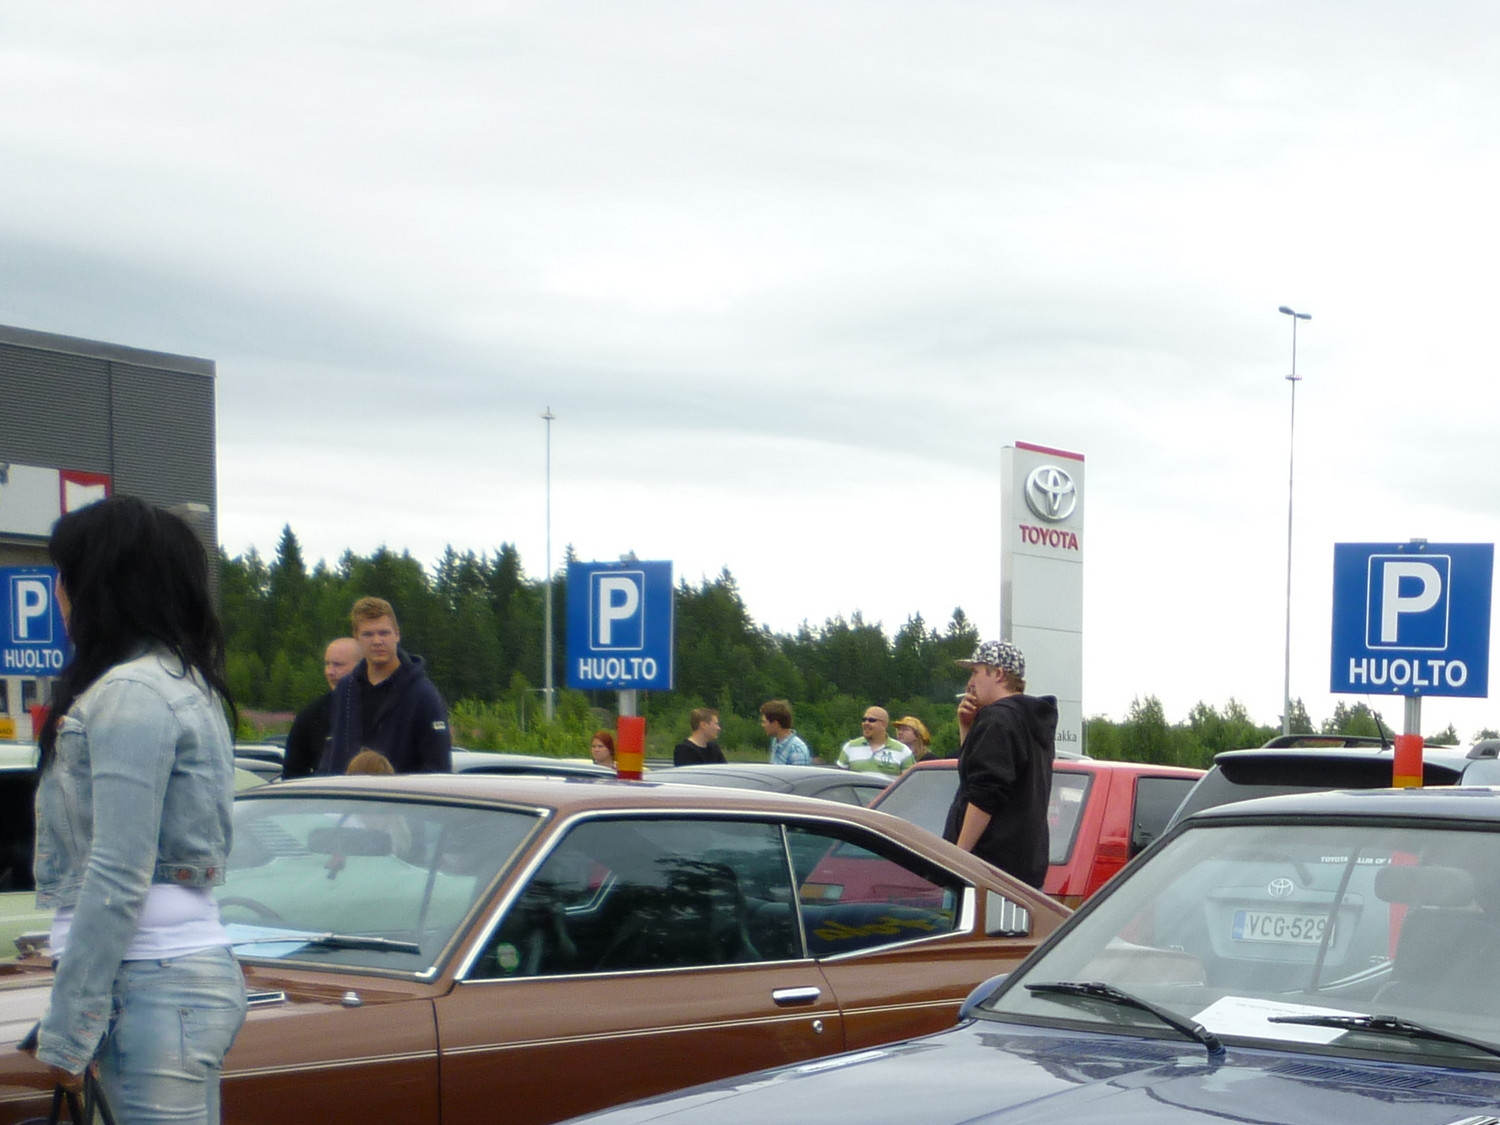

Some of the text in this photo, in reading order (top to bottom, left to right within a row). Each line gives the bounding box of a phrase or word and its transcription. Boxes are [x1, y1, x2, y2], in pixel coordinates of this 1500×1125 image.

[1018, 524, 1079, 551] TOYOTA
[17, 580, 48, 638] P
[599, 577, 639, 645] P
[1381, 562, 1442, 642] P
[5, 649, 64, 669] HUOLTO
[579, 657, 658, 680] HUOLTO
[1349, 658, 1468, 687] HUOLTO
[1320, 855, 1348, 864] TOYOTA
[1249, 914, 1328, 941] VCG-529
